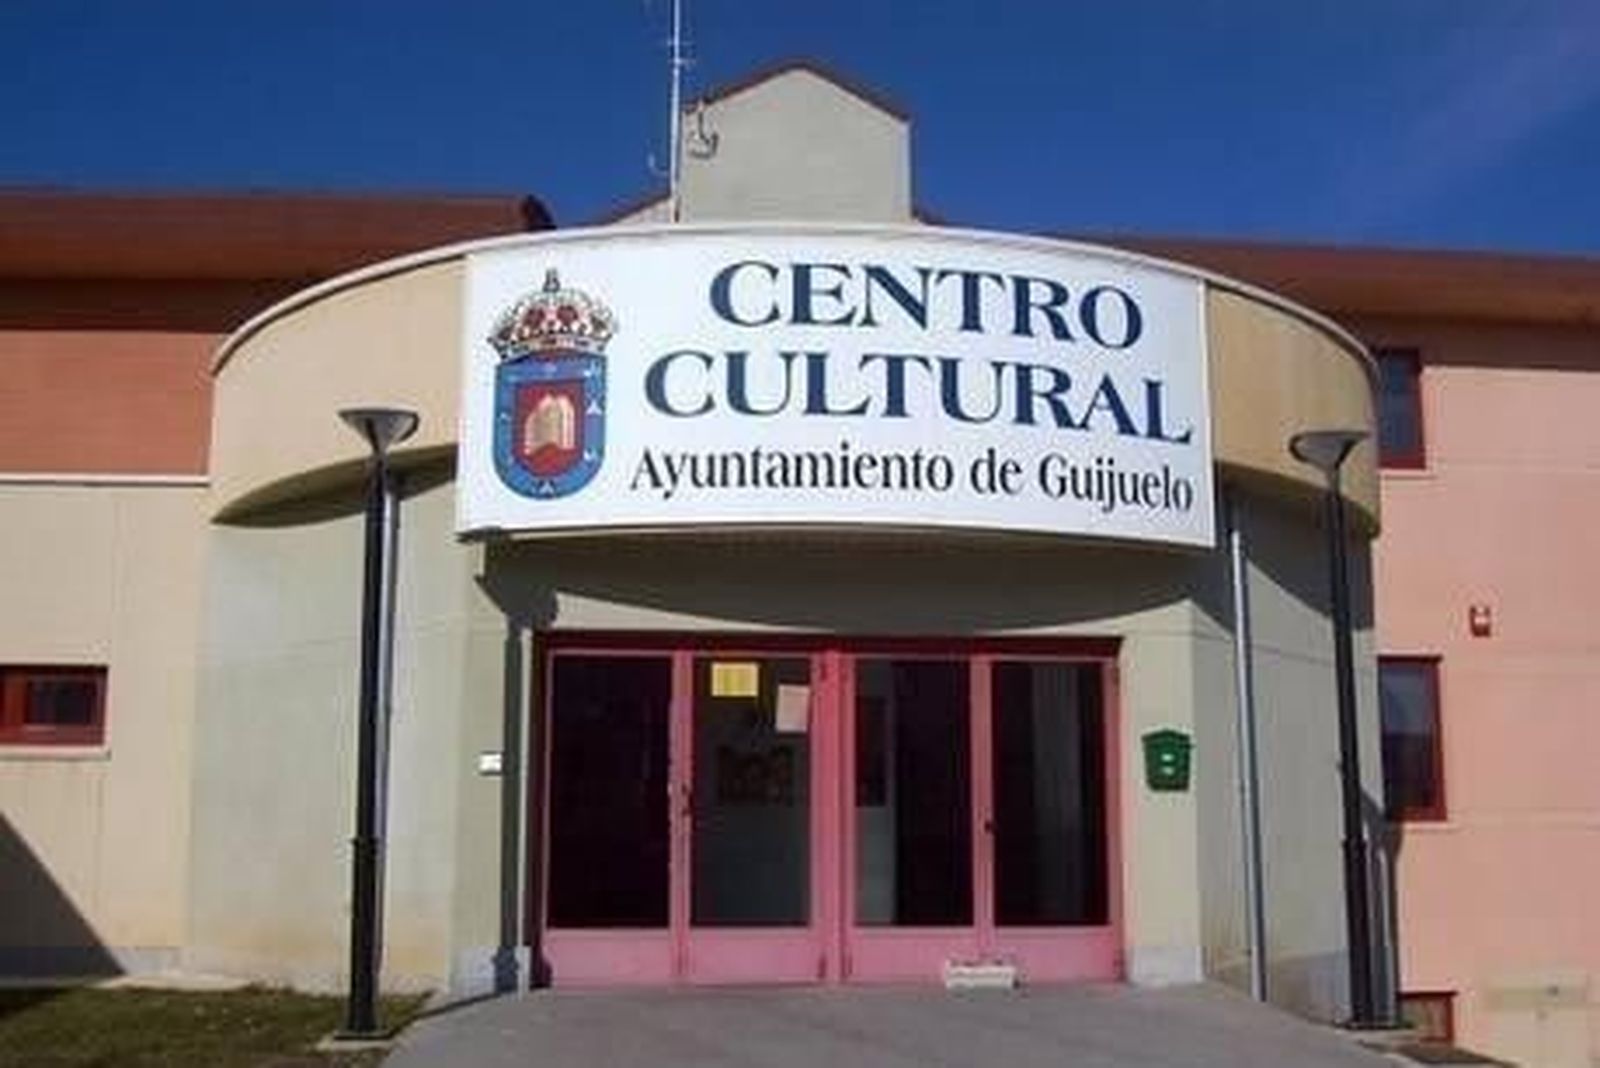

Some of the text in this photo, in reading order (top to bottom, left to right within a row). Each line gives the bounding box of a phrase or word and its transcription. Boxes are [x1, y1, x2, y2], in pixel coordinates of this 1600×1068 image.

[709, 260, 1143, 351] CENTRO
[643, 350, 1193, 445] CULTURAL
[629, 440, 1194, 513] Ayuntamiento de Guijuelo
